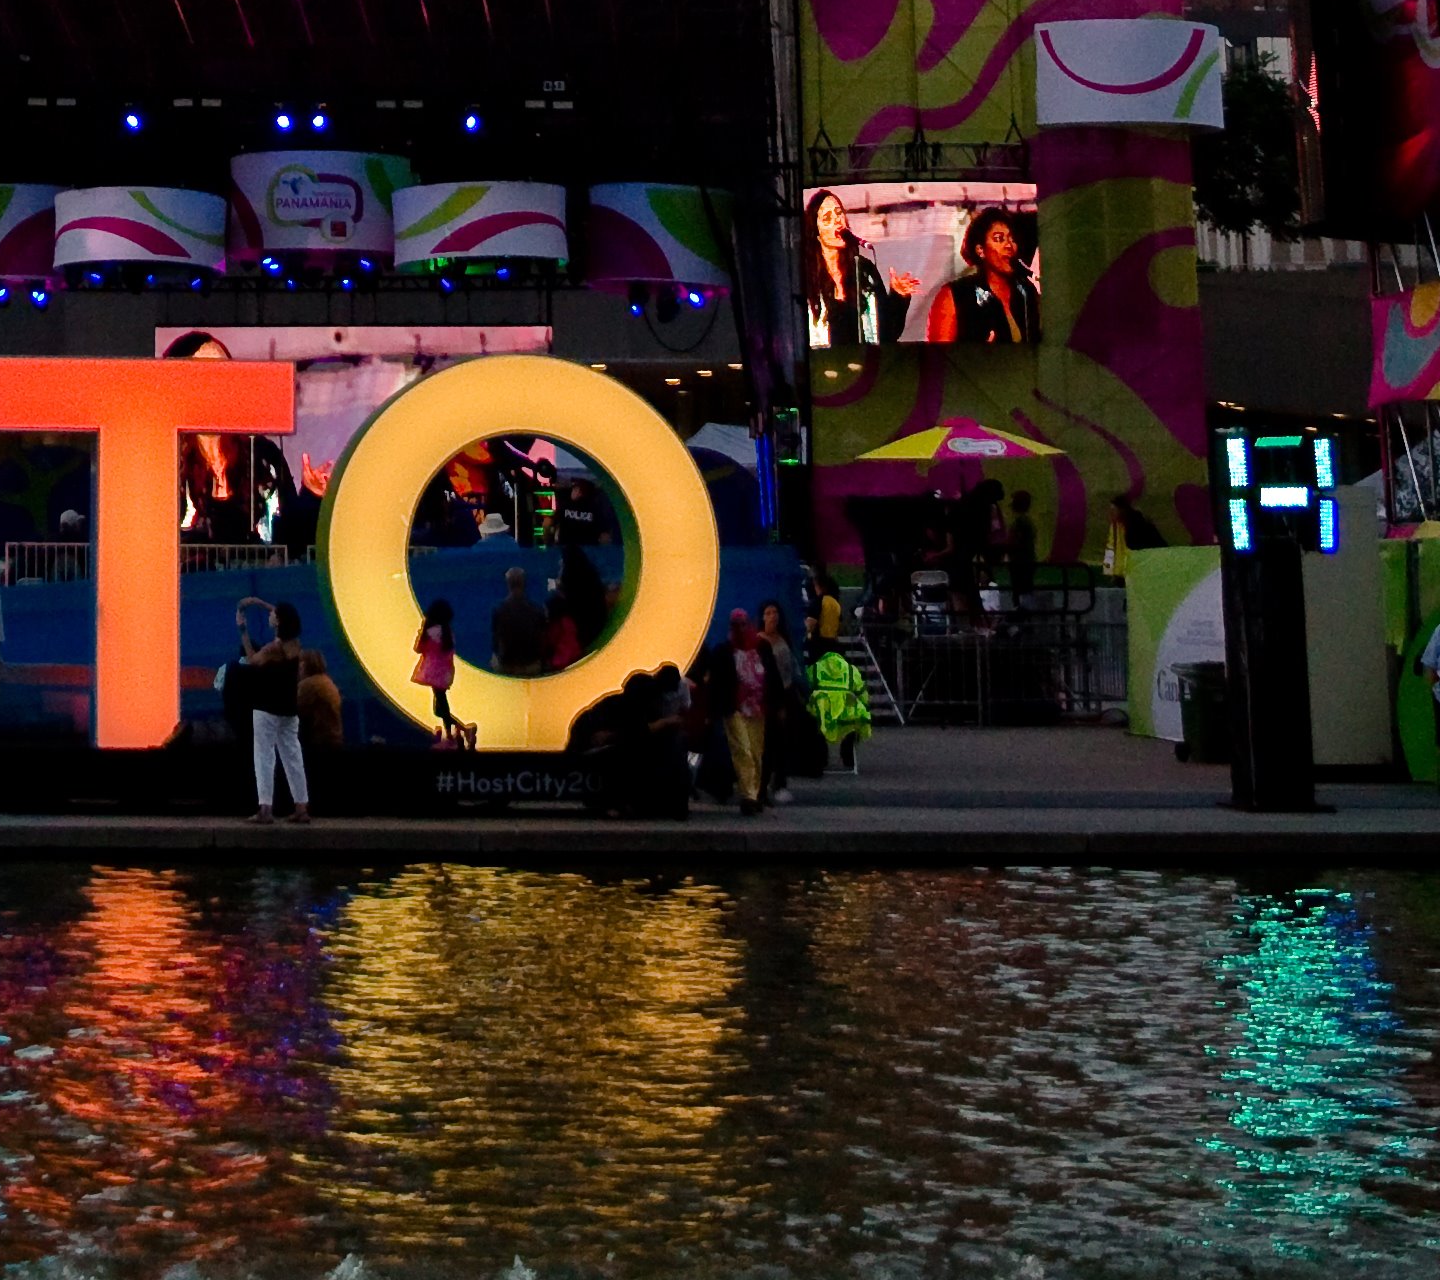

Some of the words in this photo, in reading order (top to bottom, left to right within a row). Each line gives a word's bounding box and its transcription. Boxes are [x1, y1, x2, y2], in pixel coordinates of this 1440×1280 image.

[275, 197, 352, 210] PANAMANIA
[564, 508, 593, 522] POLICE
[435, 769, 604, 798] #HostCity20
